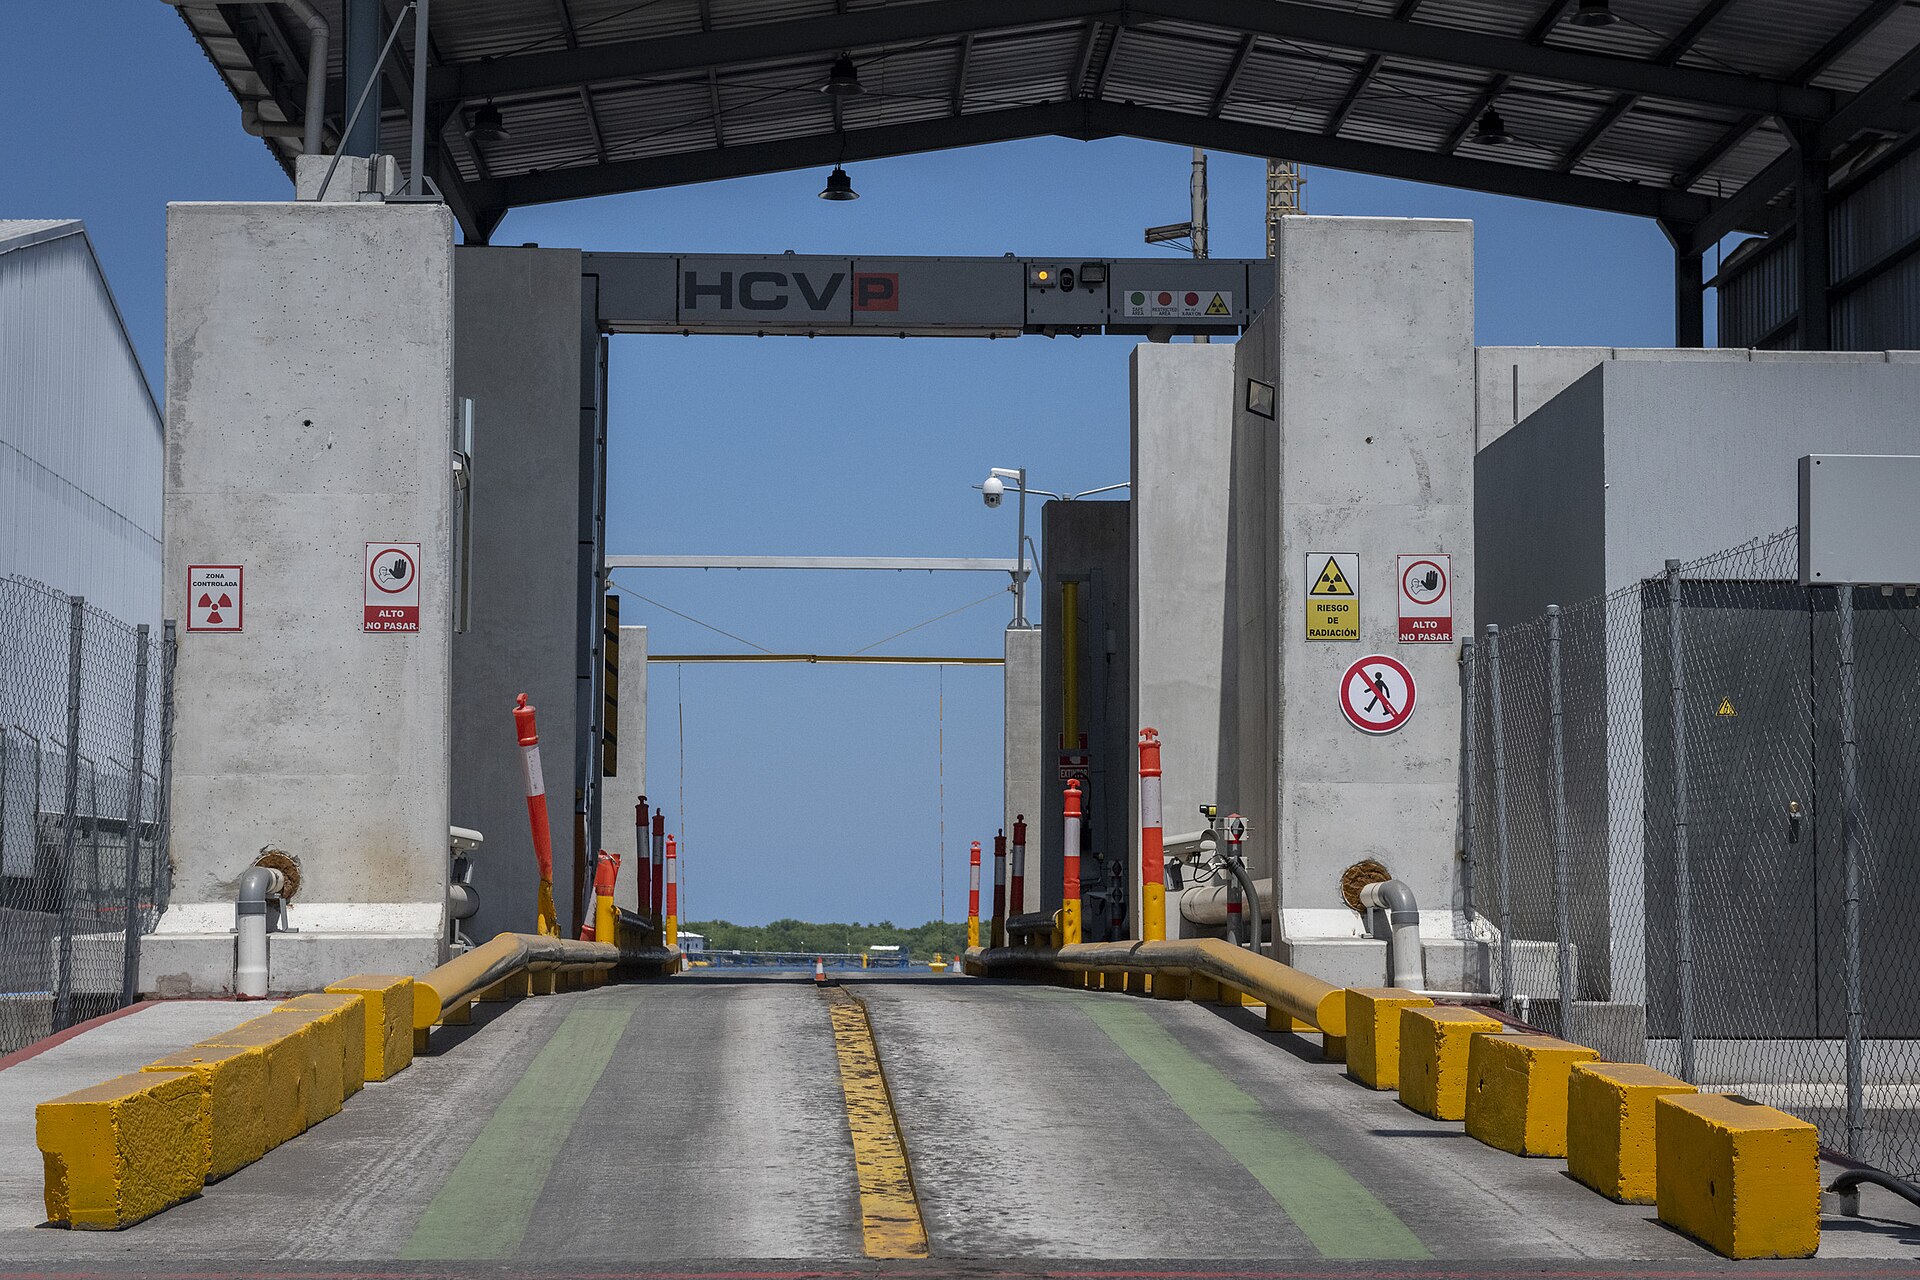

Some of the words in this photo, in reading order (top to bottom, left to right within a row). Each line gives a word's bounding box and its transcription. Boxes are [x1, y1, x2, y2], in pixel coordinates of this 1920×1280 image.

[1317, 604, 1349, 612] RIESGO
[378, 610, 404, 618] ALTO
[367, 622, 381, 630] NO
[383, 622, 416, 630] PASAR
[1412, 621, 1438, 629] ALTO
[1309, 628, 1357, 637] RADIACIÓN
[1401, 633, 1416, 641] NO
[1417, 633, 1450, 641] PASAR
